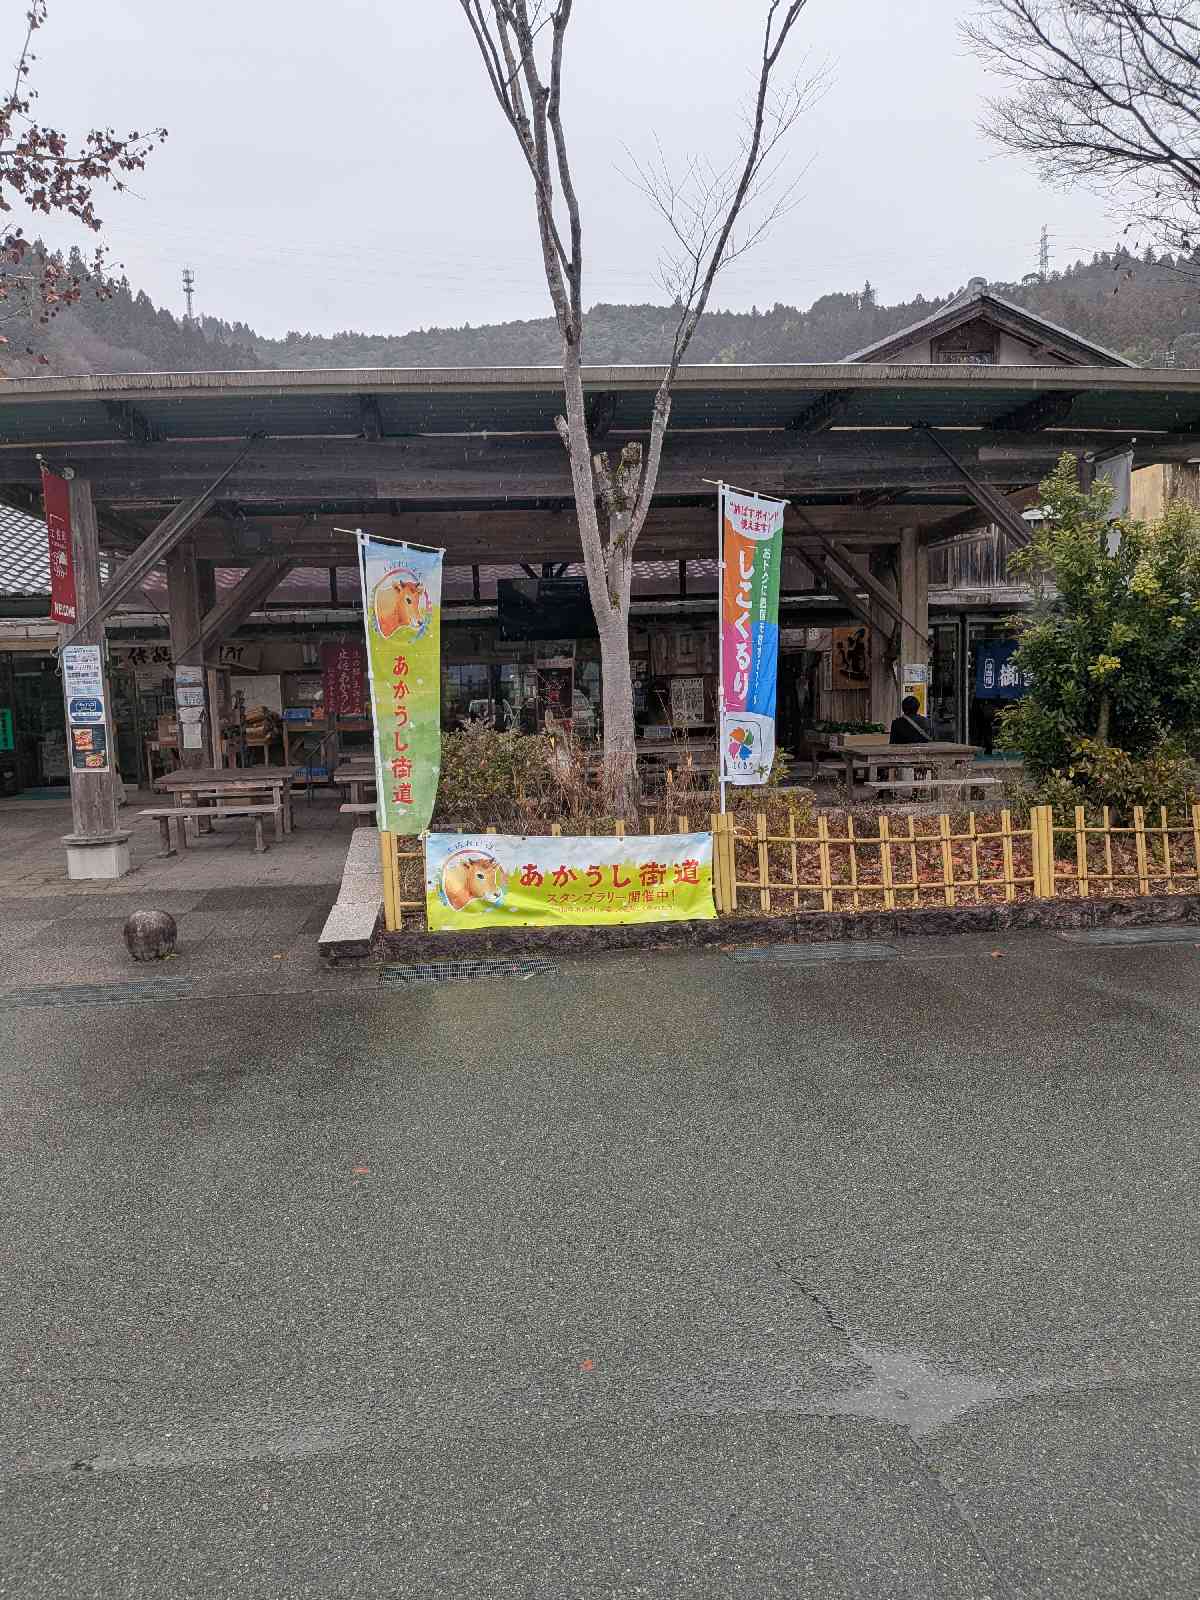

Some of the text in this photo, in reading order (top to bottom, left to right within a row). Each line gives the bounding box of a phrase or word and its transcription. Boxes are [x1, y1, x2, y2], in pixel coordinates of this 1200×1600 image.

[54, 602, 76, 618] WELCOME
[733, 551, 756, 700] しこくるり
[391, 655, 416, 805] あかうし街道
[519, 858, 702, 889] あかうし街道
[546, 887, 676, 906] スタンプラリー開催中!
